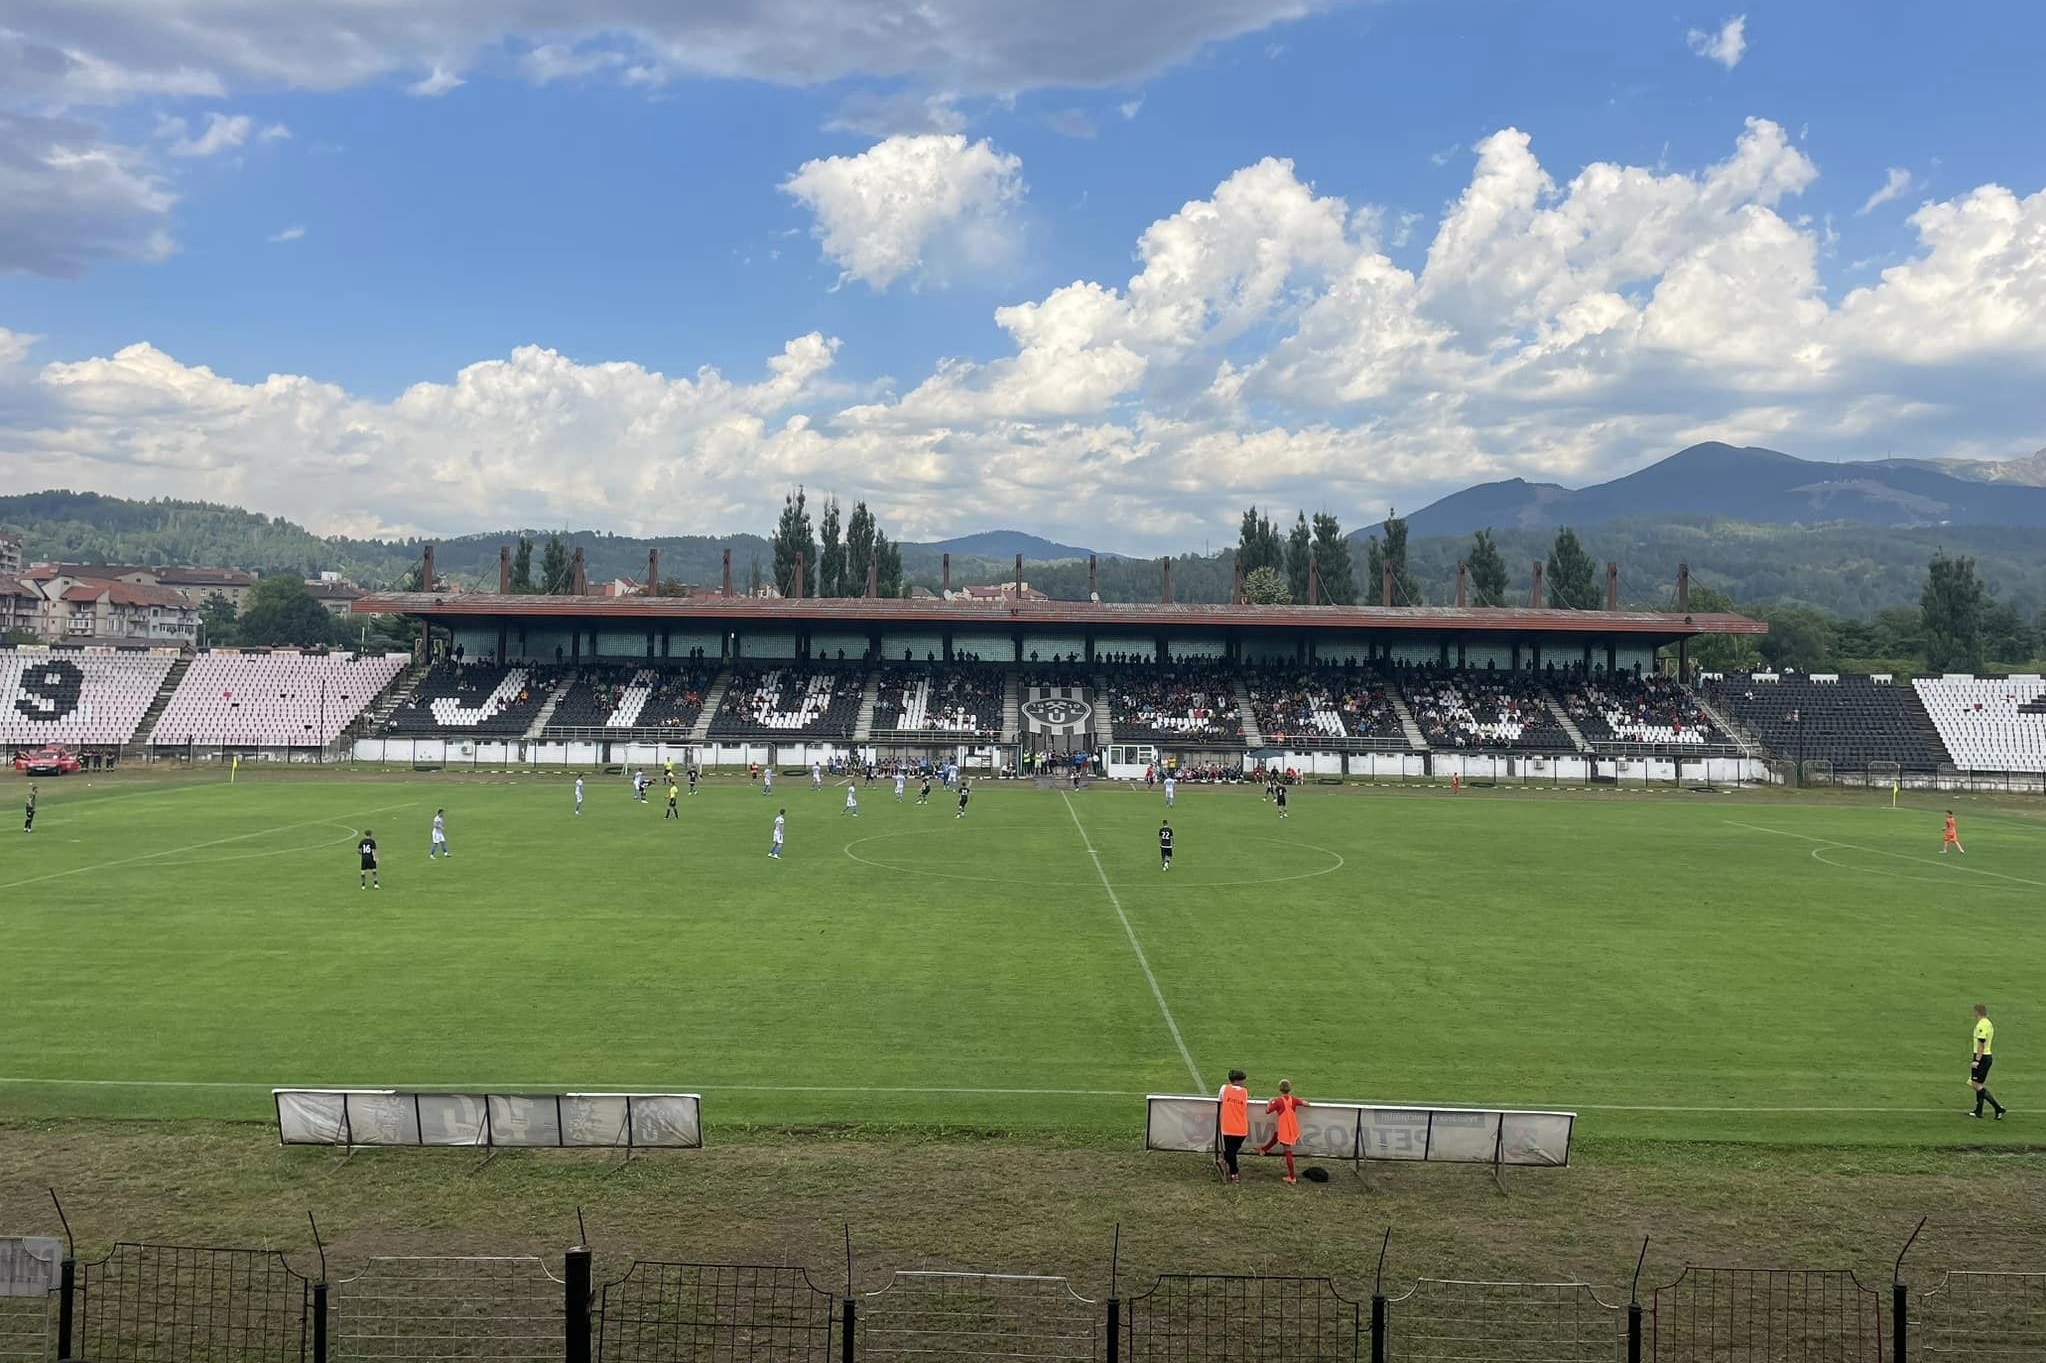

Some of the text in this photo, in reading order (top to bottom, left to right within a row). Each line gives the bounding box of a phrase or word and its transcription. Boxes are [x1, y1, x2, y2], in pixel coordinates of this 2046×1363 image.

[14, 660, 84, 721] 9
[1161, 831, 1170, 840] 22
[362, 844, 371, 854] 16
